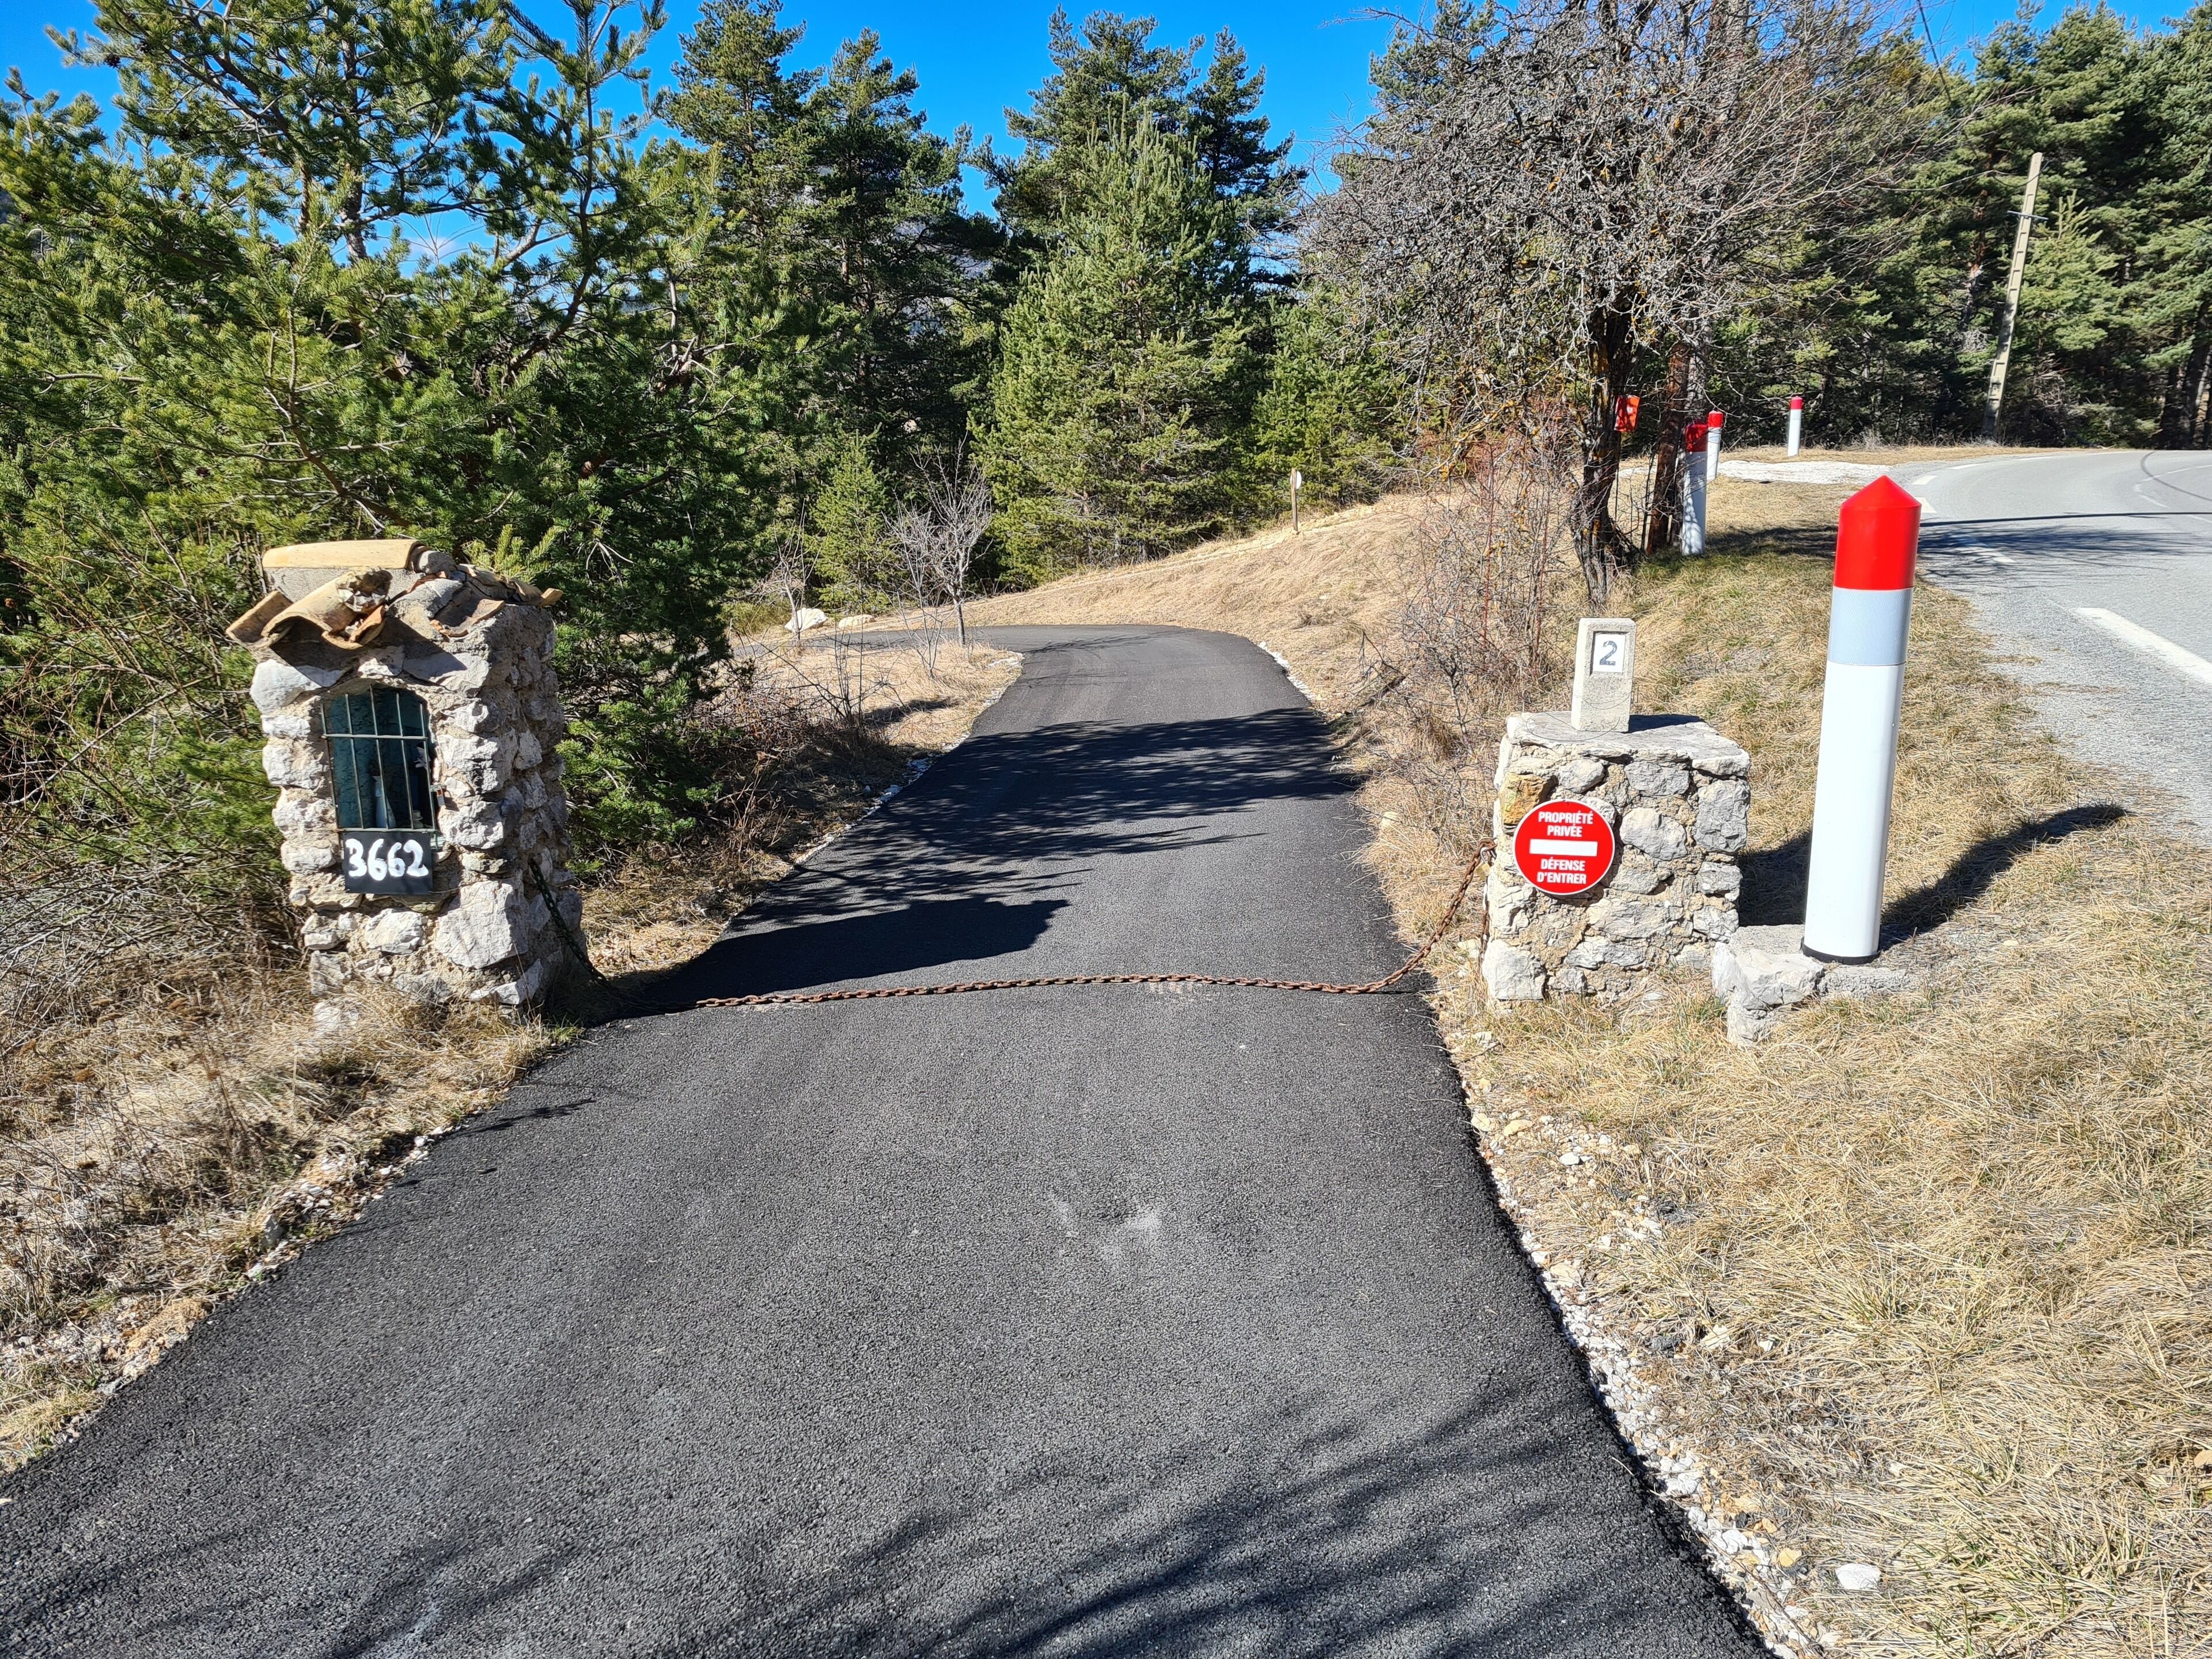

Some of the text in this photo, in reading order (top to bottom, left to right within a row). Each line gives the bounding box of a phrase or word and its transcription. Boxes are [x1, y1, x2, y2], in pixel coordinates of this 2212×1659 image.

[1599, 641, 1617, 666] 2
[1539, 810, 1593, 824] PROPRIÉTÉ
[1547, 824, 1582, 837] PRIVÉE
[346, 839, 429, 881] 3662
[1541, 857, 1585, 871] DÉFENSE
[1537, 872, 1586, 884] D'ENTRER
